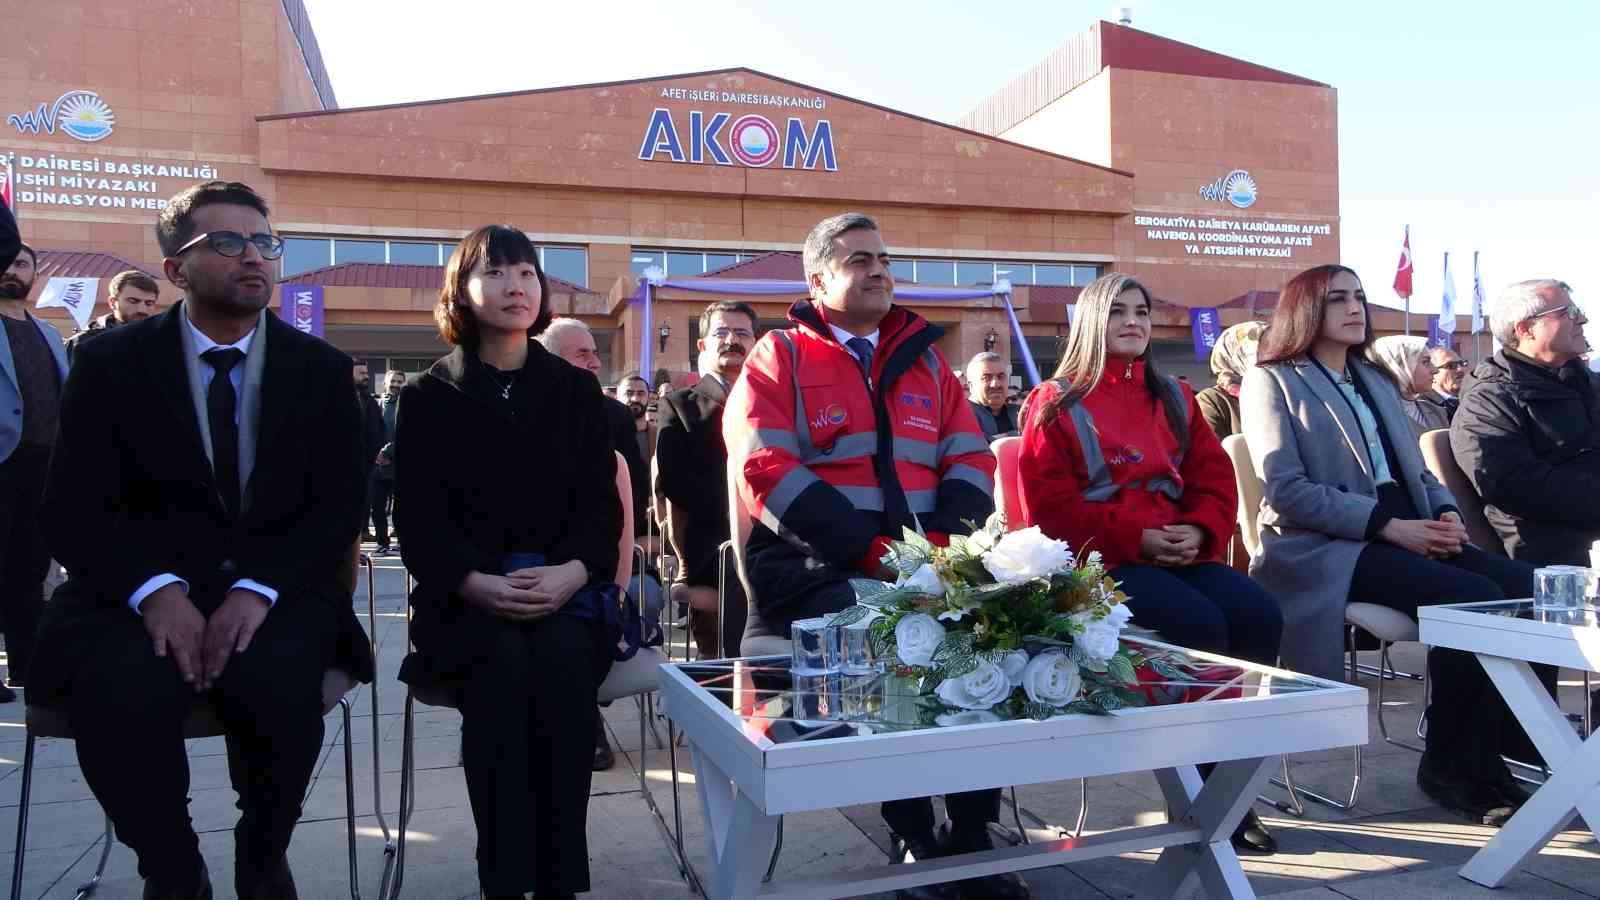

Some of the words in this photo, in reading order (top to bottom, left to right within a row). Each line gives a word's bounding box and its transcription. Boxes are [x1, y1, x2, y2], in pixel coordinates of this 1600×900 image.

[661, 88, 688, 99] AFET
[638, 108, 838, 171] AKOM
[21, 154, 100, 172] DAİRESİ
[104, 162, 218, 179] BAŞKANLIĞI
[1148, 230, 1196, 241] NAVENDA
[1184, 245, 1200, 254] YA
